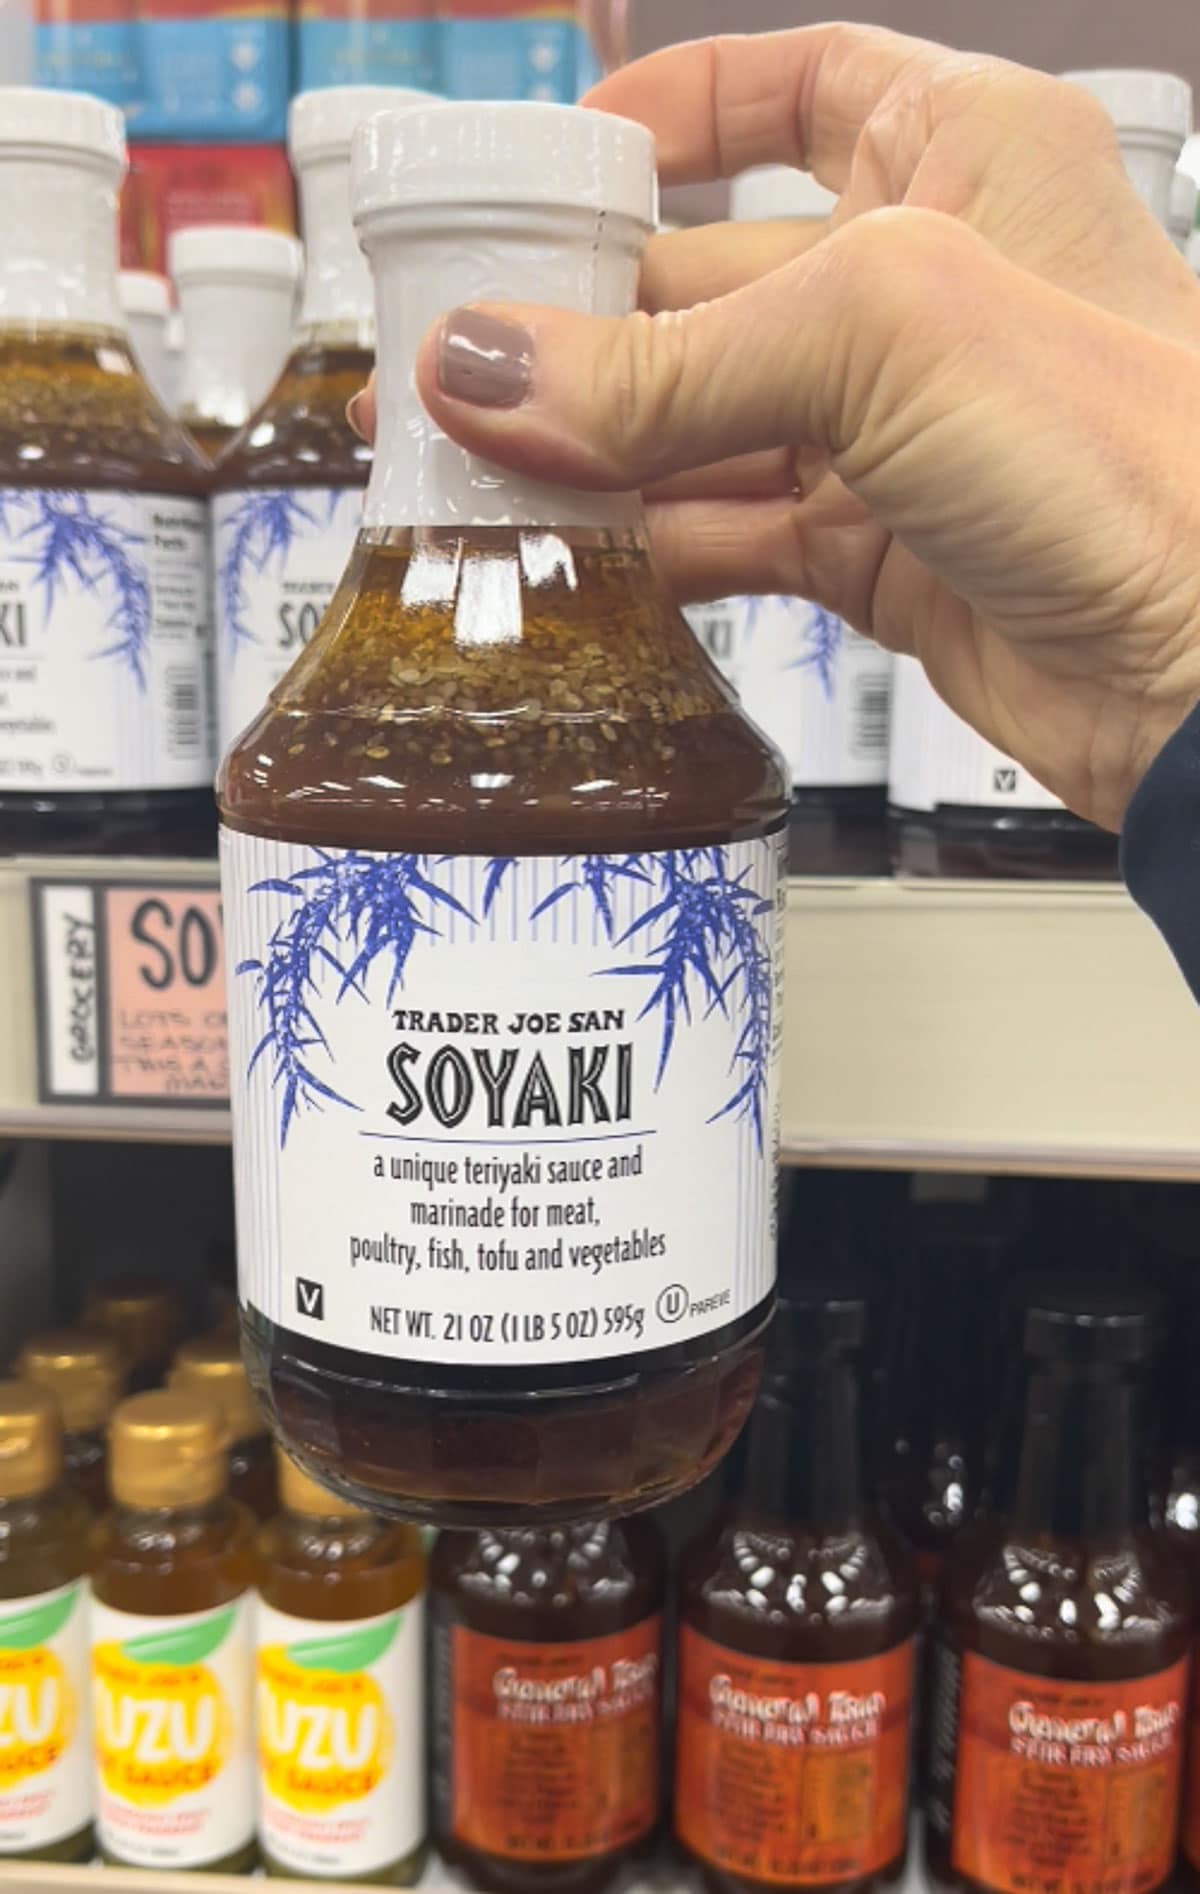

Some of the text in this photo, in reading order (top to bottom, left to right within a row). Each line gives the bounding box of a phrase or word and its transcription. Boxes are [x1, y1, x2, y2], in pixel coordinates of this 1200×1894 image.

[393, 1009, 624, 1034] TRADER JOE SAN
[385, 1041, 633, 1129] SOYAKI
[374, 1144, 643, 1193] a unique teriyaki sauce and
[410, 1196, 600, 1227] marinade for meat,
[350, 1227, 666, 1275] poultry, fish, tofu and vegetables
[370, 1305, 400, 1335] NET
[406, 1309, 437, 1340] WT.
[443, 1313, 462, 1341] 21
[470, 1314, 494, 1342] OZ
[524, 1314, 544, 1342] LB
[550, 1312, 561, 1340] 5
[566, 1307, 598, 1338] OZ)
[603, 1303, 645, 1339] 595g
